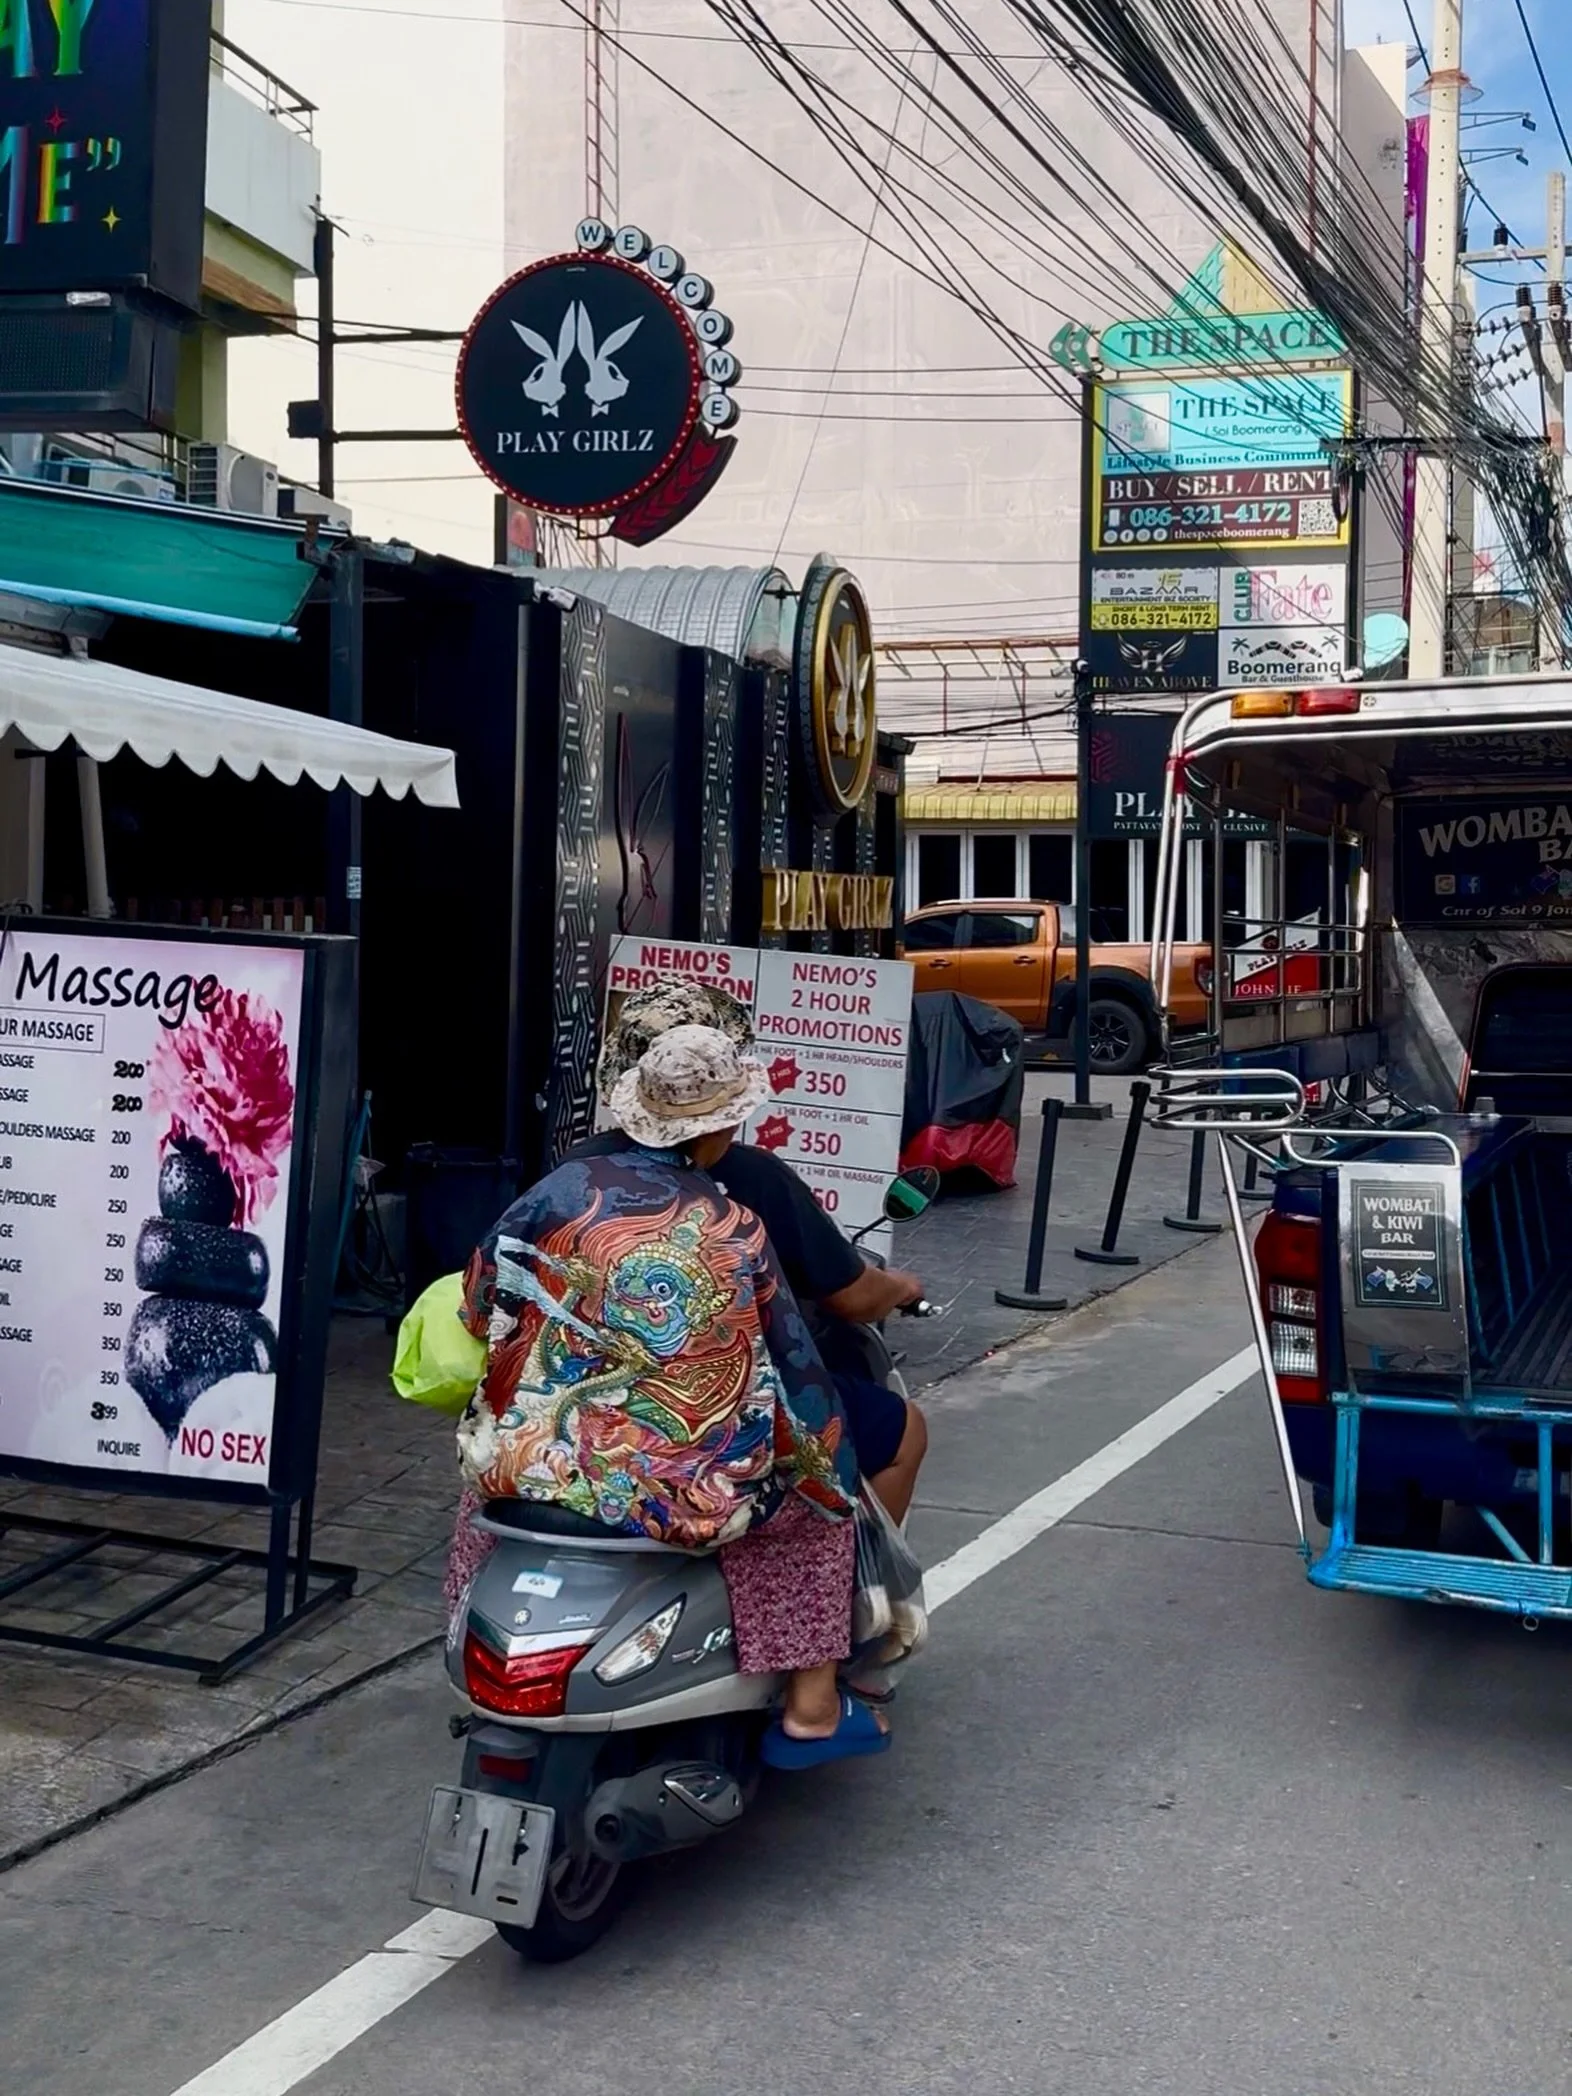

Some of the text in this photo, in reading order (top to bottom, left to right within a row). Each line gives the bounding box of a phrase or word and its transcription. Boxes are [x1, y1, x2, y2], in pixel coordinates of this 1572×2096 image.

[580, 225, 729, 418] WELCOME
[1121, 319, 1330, 358] THE SPACE
[1176, 397, 1238, 419] THE
[496, 429, 654, 453] PLAY GIRLZ
[1107, 453, 1171, 471] Lifestyle
[1175, 452, 1241, 466] Business
[1109, 478, 1160, 500] BUY
[1176, 473, 1242, 496] SELL
[1263, 469, 1332, 493] RENT
[1130, 501, 1292, 528] 086-321-4172
[1174, 526, 1290, 541] thespaceboomerang
[1109, 586, 1199, 596] BAZAAR
[1233, 570, 1252, 623] CLUB
[1250, 569, 1333, 622] Fate
[1112, 605, 1137, 613] SHORT
[1146, 605, 1167, 613] LONG
[1168, 604, 1189, 612] TERM
[1190, 604, 1211, 612] RENT
[1111, 612, 1212, 626] 086-321-4172
[1227, 659, 1342, 678] Boomerang
[1241, 675, 1257, 683] Bar
[1270, 674, 1324, 683] Guesthouse
[1210, 822, 1269, 833] CLUSIVE
[774, 868, 894, 931] PLAY GIRLZ
[1441, 904, 1473, 917] Cnr
[1476, 905, 1497, 919] of
[1531, 904, 1544, 915] 9
[641, 945, 731, 975] NEMO'S
[610, 965, 754, 1001] PROON
[792, 962, 877, 989] NEMO'S
[15, 951, 219, 1030] Massage
[791, 988, 871, 1016] 2 HOUR
[22, 1019, 95, 1043] MASSAGE
[758, 1013, 903, 1047] PROMOTIONS
[774, 1047, 797, 1057] FOOT
[813, 1053, 826, 1062] HR
[112, 1059, 146, 1079] 200
[804, 1070, 847, 1097] 350
[111, 1093, 143, 1113] 200
[799, 1109, 823, 1120] FOOT
[840, 1115, 853, 1124] HR
[854, 1116, 870, 1126] OIL
[45, 1125, 96, 1144] MASSAGE
[111, 1130, 131, 1146] 200
[799, 1130, 842, 1156] 350
[109, 1164, 129, 1180] 200
[813, 1168, 826, 1176] HR
[827, 1169, 842, 1179] OIL
[843, 1171, 885, 1185] MASSAGE
[107, 1199, 127, 1214] 250
[812, 1187, 839, 1213] 50
[1363, 1196, 1433, 1213] WOMBAT
[1371, 1214, 1423, 1231] & KIWI
[106, 1233, 126, 1248] 250
[1380, 1232, 1416, 1245] BAR
[104, 1267, 124, 1283] 250
[102, 1302, 122, 1317] 350
[101, 1336, 121, 1352] 350
[99, 1370, 119, 1386] 350
[90, 1401, 118, 1421] 399
[97, 1438, 142, 1457] INQUIRE
[181, 1426, 267, 1467] NO SEX
